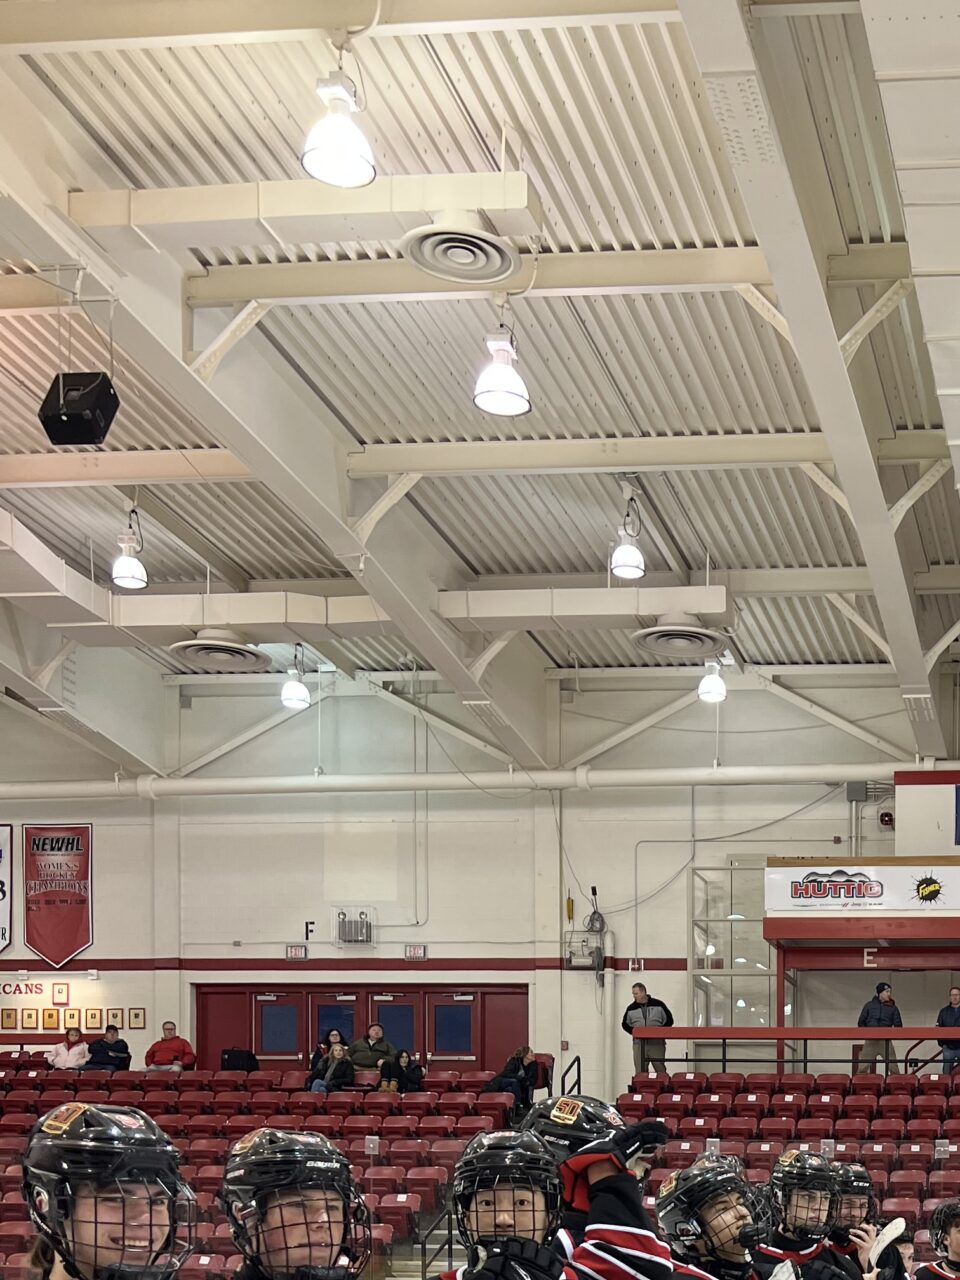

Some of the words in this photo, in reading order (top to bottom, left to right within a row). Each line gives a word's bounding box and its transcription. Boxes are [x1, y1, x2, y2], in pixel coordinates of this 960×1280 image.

[31, 836, 84, 852] NEWHL
[305, 921, 315, 940] F
[863, 948, 878, 968] E
[0, 983, 43, 995] CANS
